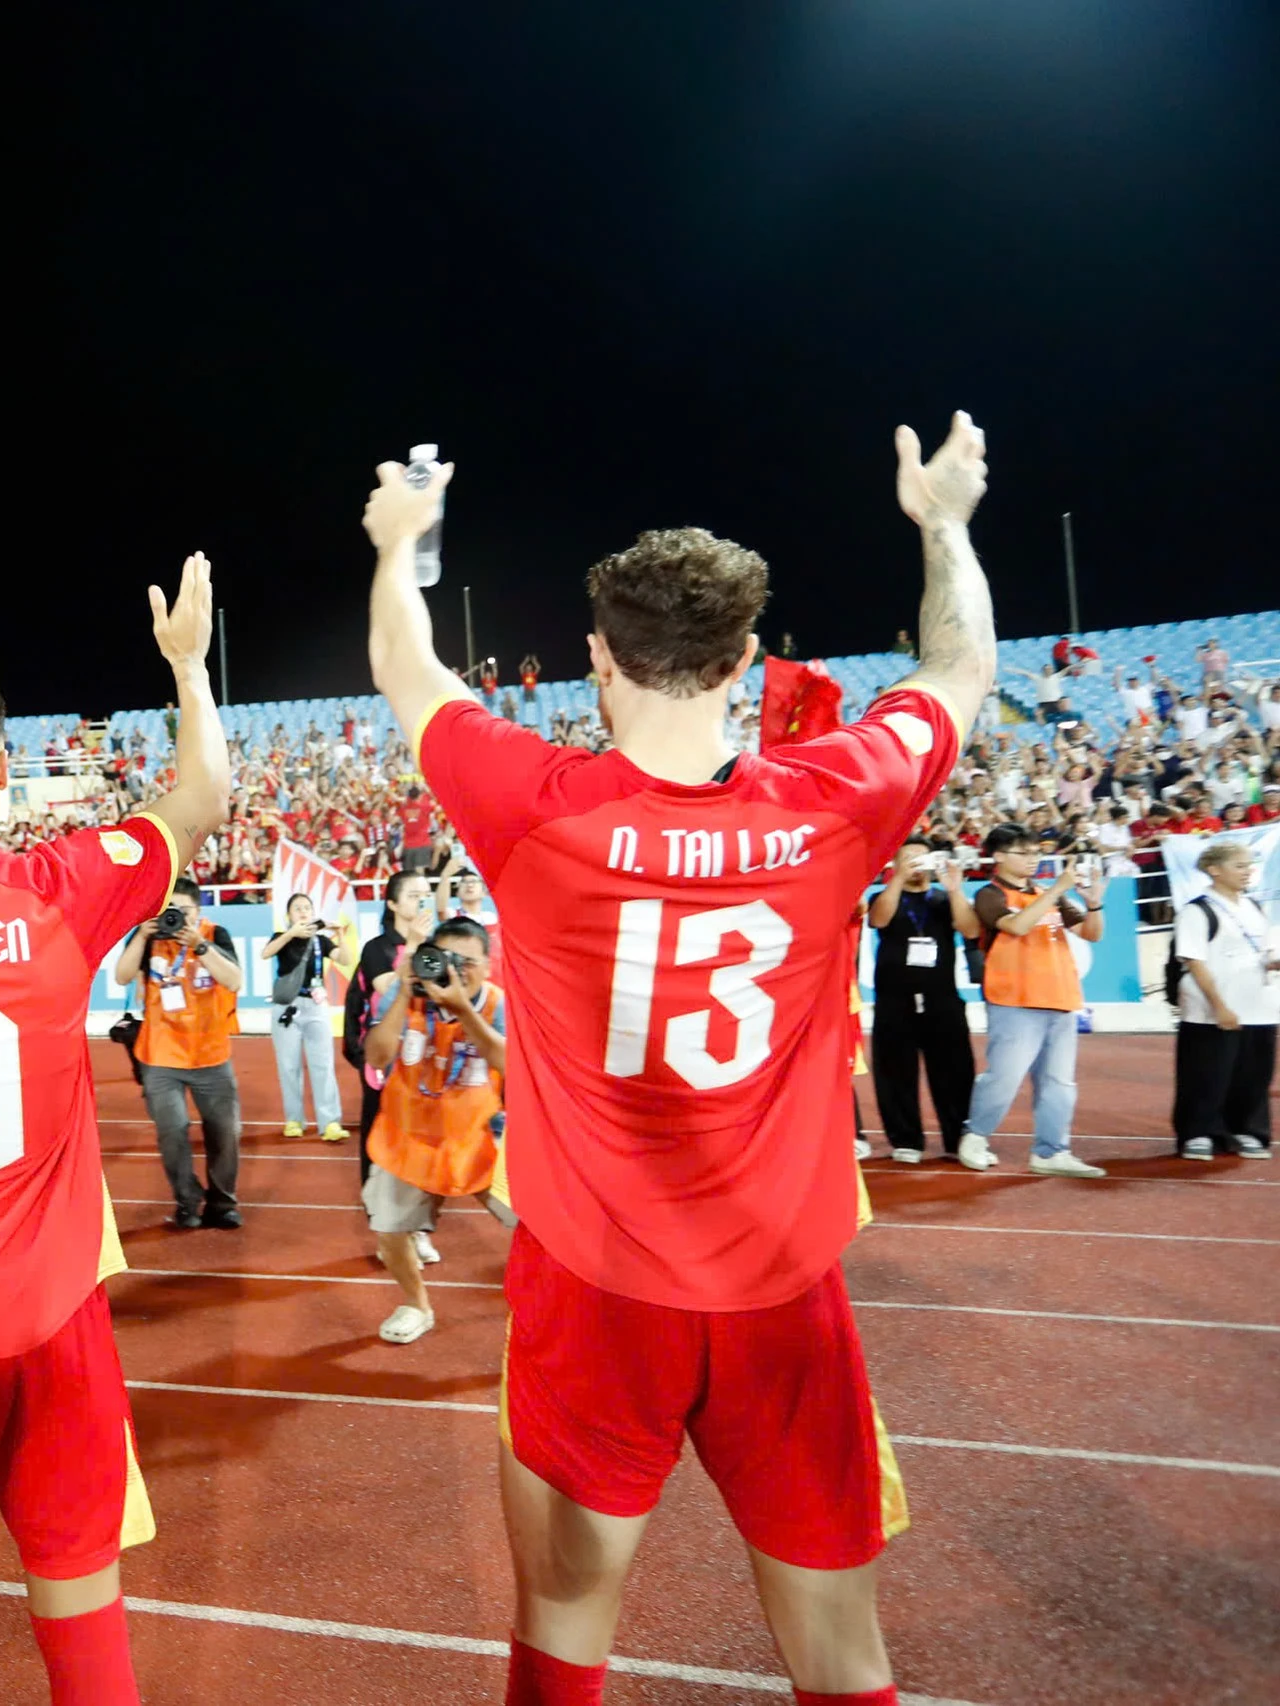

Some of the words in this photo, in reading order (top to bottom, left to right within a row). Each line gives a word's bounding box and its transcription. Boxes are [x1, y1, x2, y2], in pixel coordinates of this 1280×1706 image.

[607, 825, 644, 874] N.
[661, 829, 724, 878] TAI
[604, 898, 793, 1090] 13
